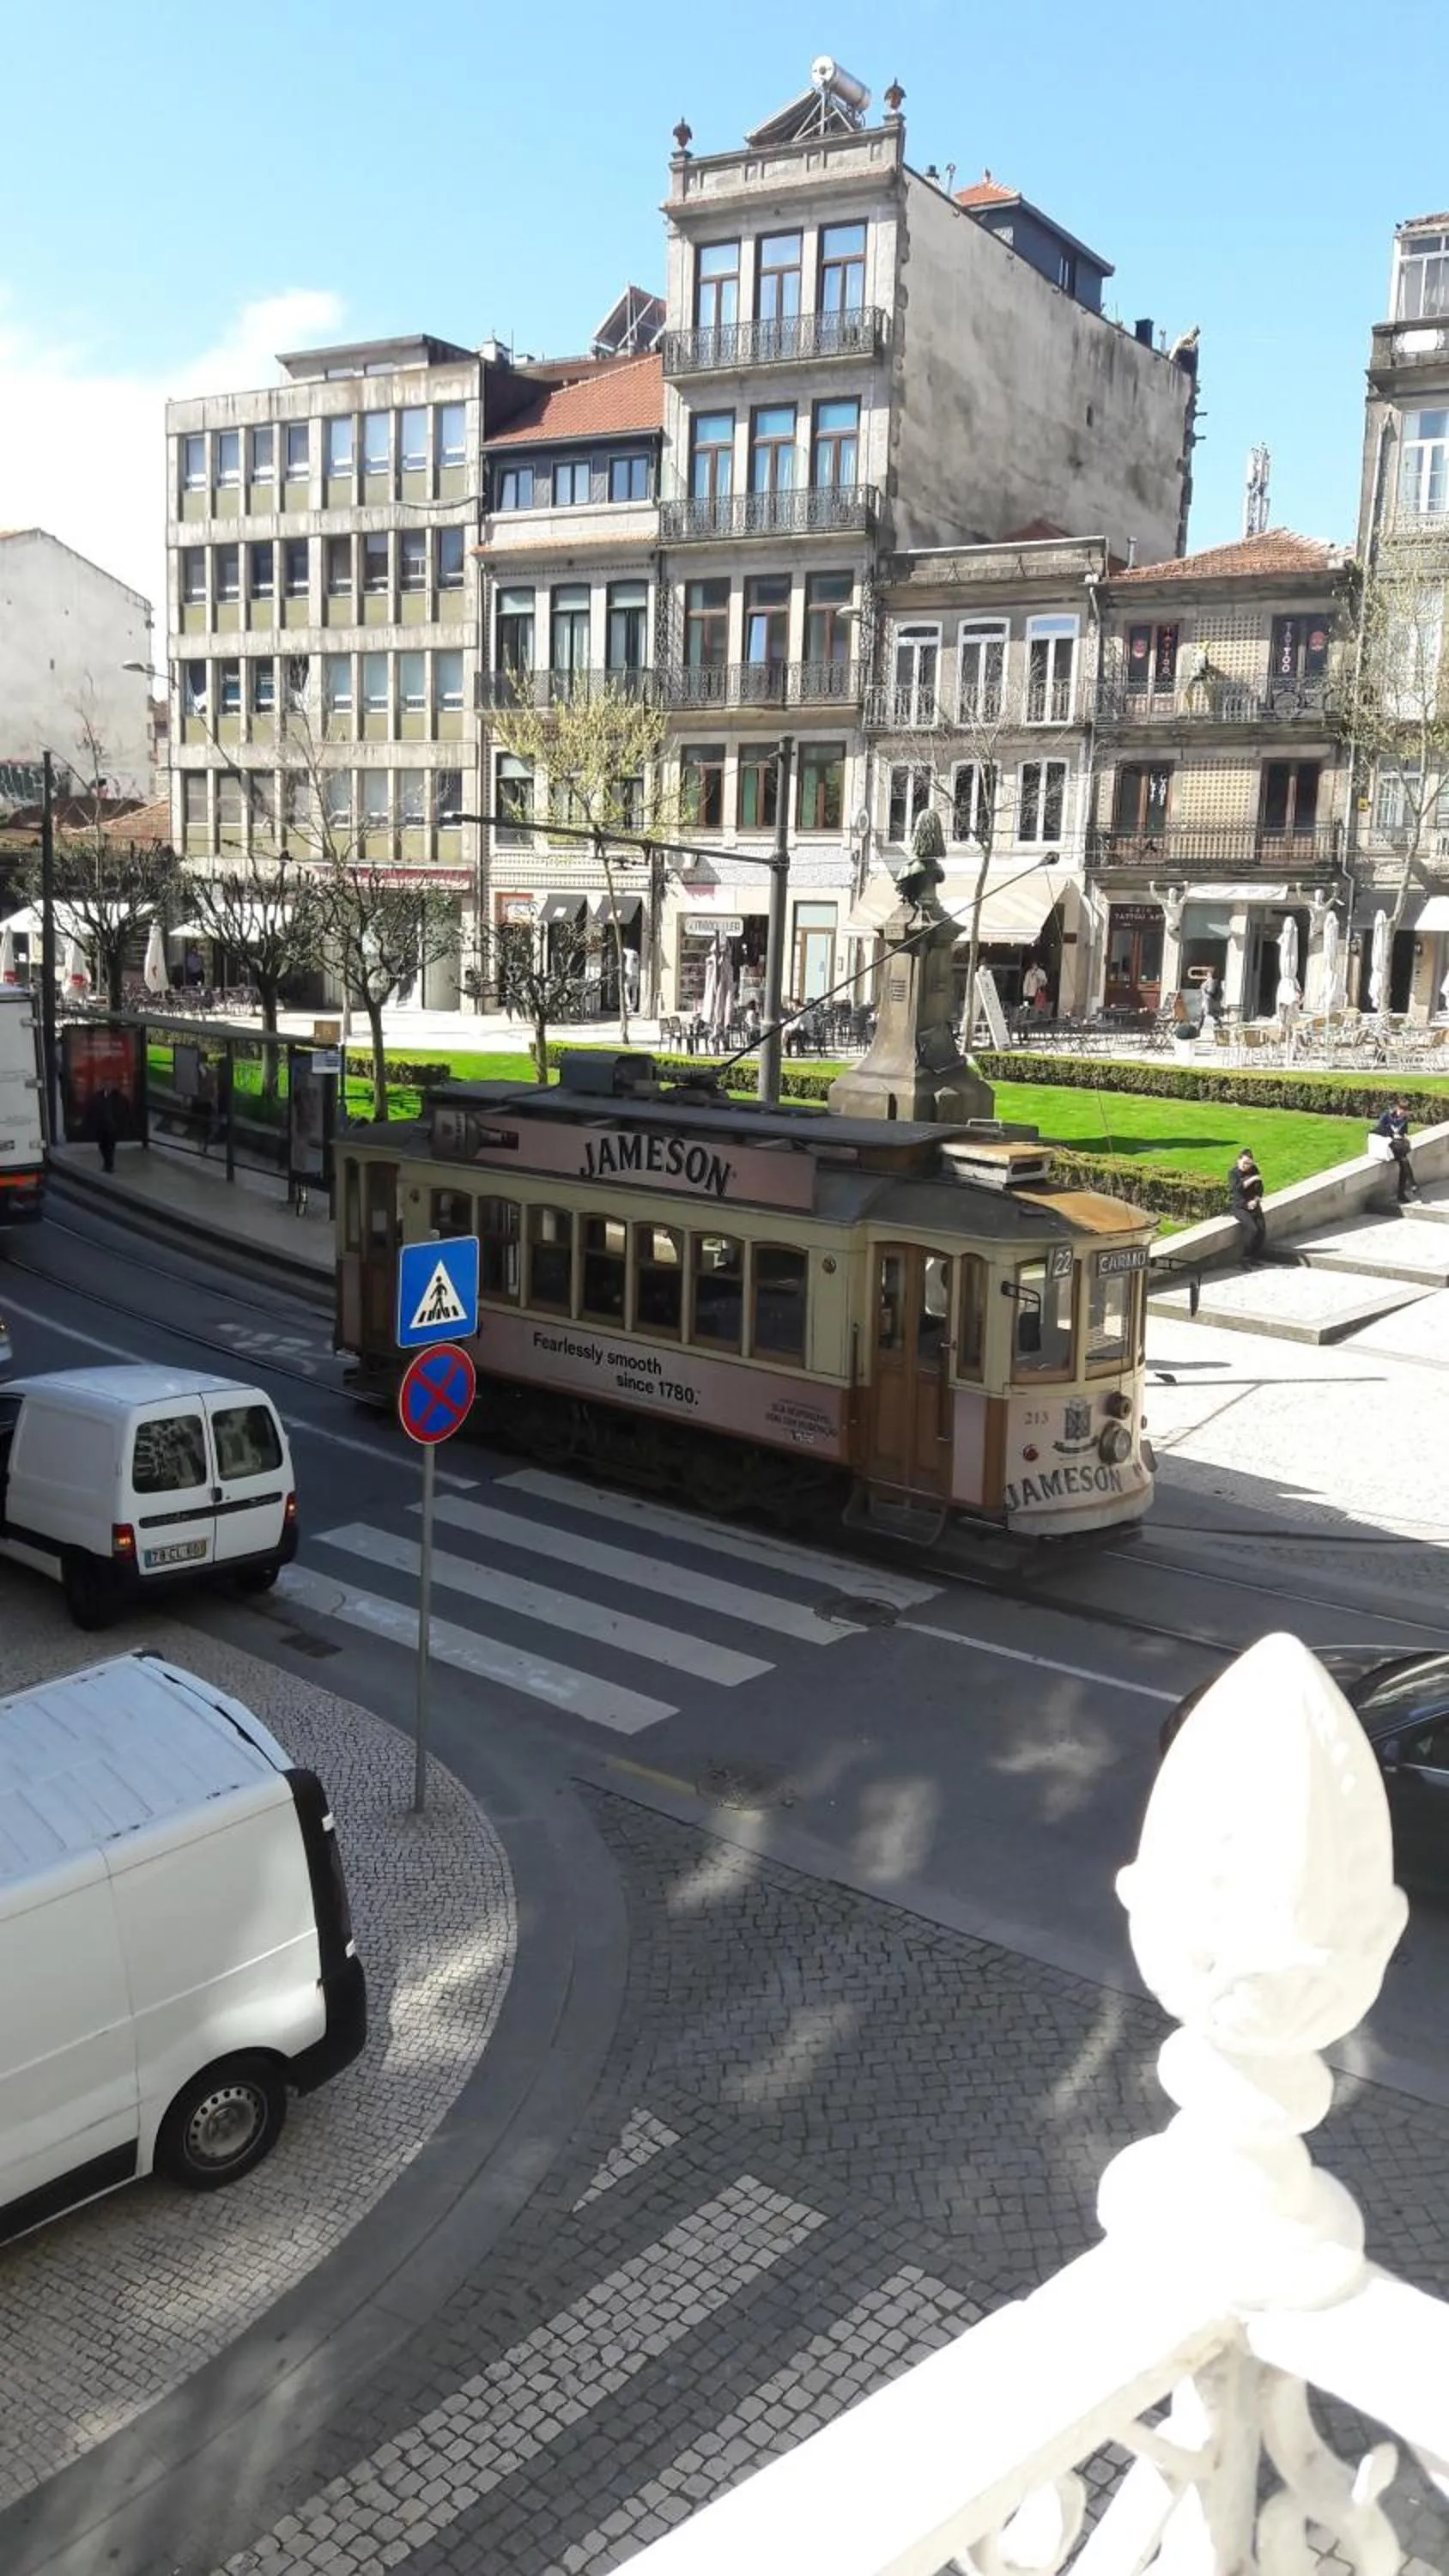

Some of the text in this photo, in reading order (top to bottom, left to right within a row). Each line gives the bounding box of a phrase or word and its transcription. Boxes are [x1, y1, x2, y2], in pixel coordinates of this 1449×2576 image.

[1282, 621, 1292, 673] TATTOO
[579, 1133, 731, 1196] JAMESON
[1052, 1249, 1072, 1277] 22
[1100, 1250, 1147, 1272] CARMO
[532, 1331, 663, 1376] Fearlessly smooth
[615, 1372, 655, 1394] since
[1003, 1464, 1123, 1511] JAMESON
